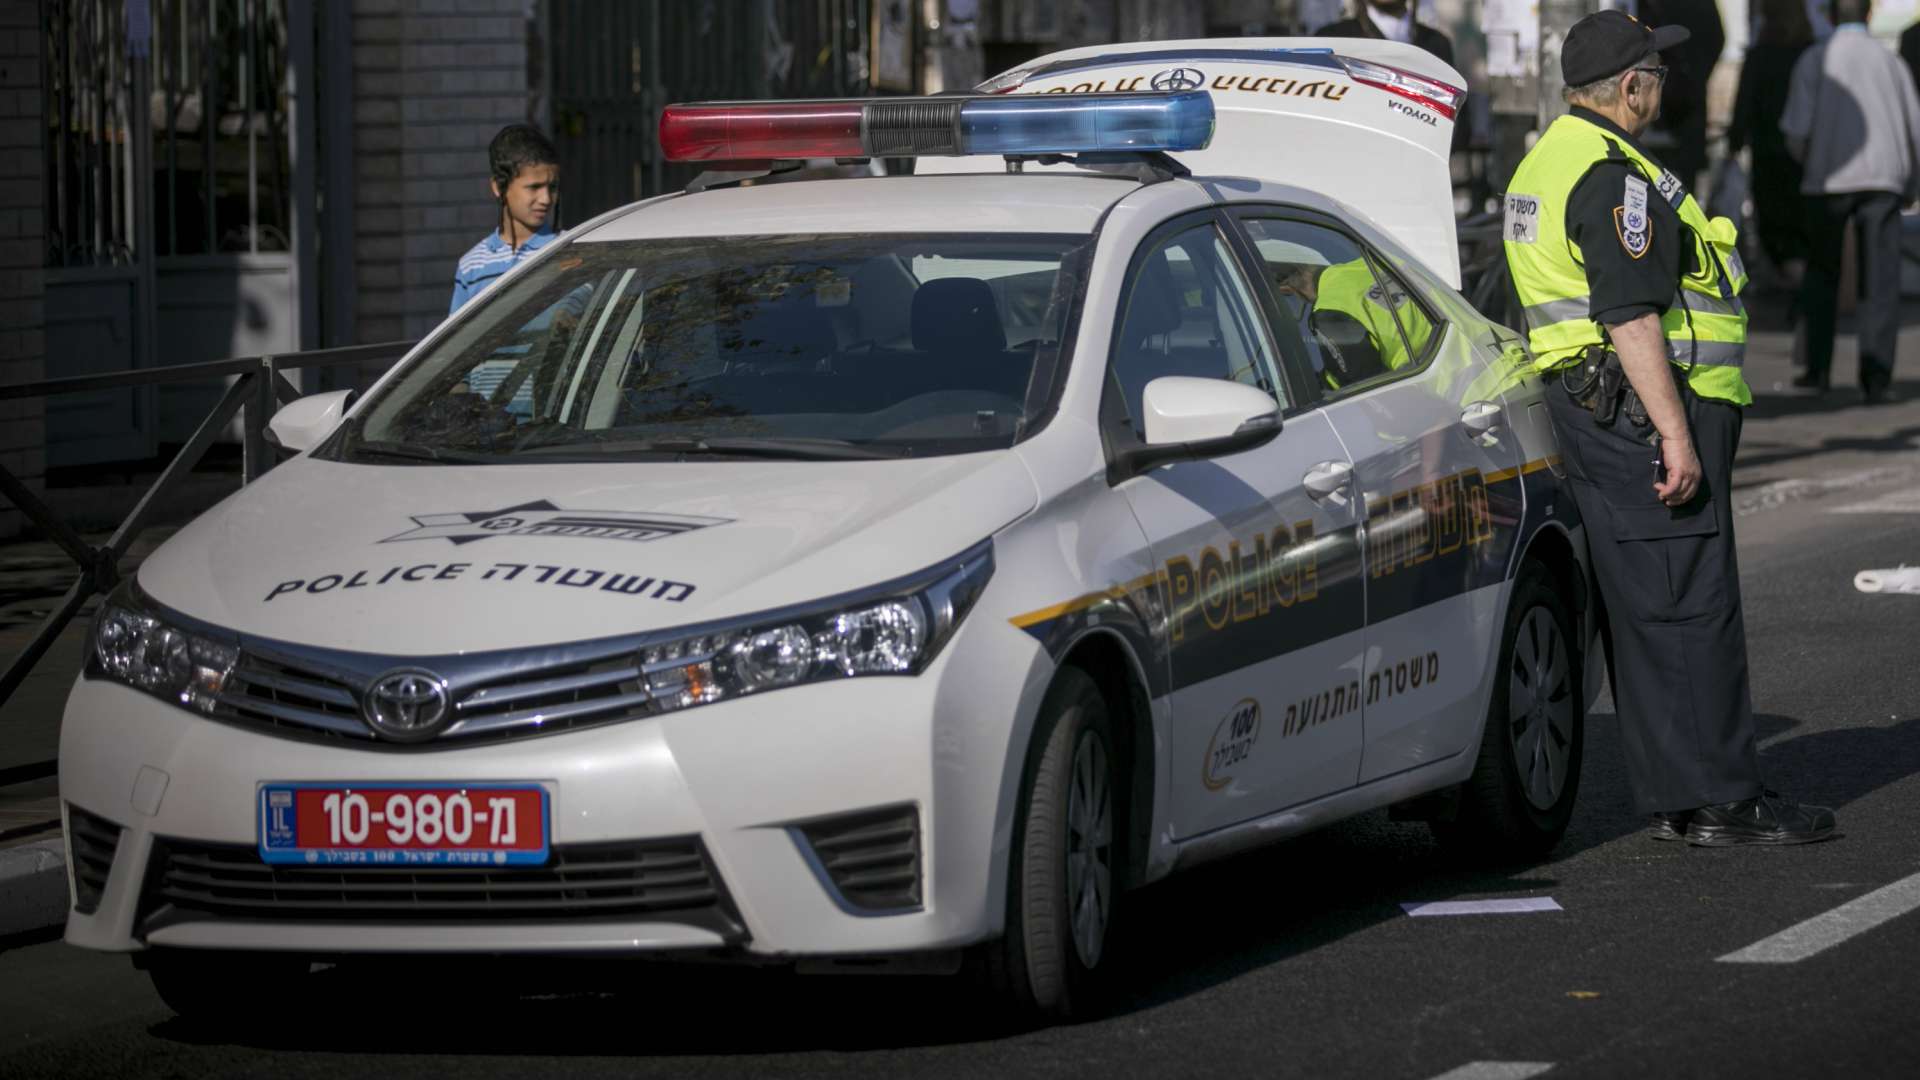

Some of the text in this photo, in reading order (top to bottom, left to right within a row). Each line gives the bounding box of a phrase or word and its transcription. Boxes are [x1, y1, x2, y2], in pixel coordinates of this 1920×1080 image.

[1211, 75, 1349, 101] התנועה
[1388, 99, 1437, 127] TOYOTA
[1510, 198, 1536, 215] משטה
[264, 562, 472, 601] POLICE
[481, 562, 697, 602] משטרה
[1165, 518, 1320, 641] POLICE
[1282, 651, 1440, 738] משטרת התנועה
[1230, 705, 1258, 741] 100
